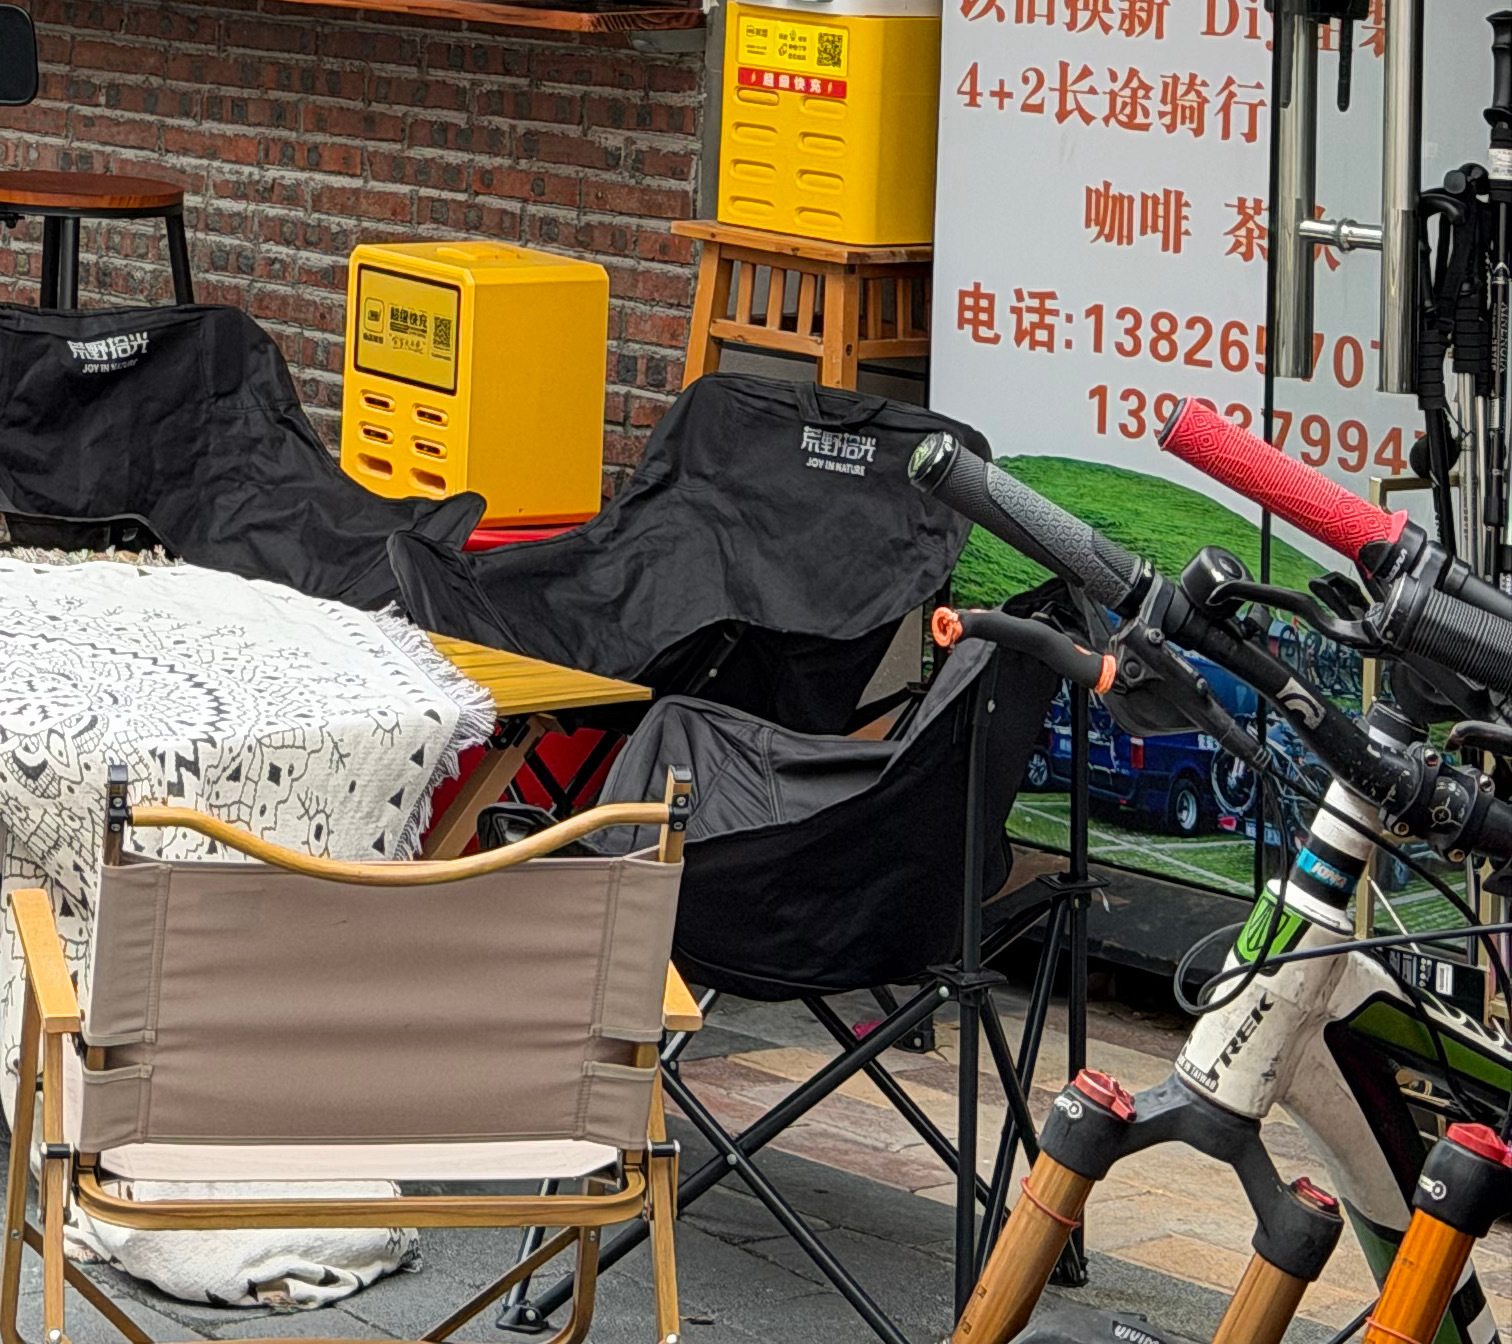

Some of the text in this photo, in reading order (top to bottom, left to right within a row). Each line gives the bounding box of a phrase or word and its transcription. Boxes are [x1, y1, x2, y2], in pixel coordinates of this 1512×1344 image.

[956, 62, 1268, 145] 4+2长途骑行
[1084, 180, 1192, 255] 咖啡
[800, 425, 877, 463] 荒野拾光
[805, 456, 825, 470] JOY
[1204, 990, 1276, 1082] TREK
